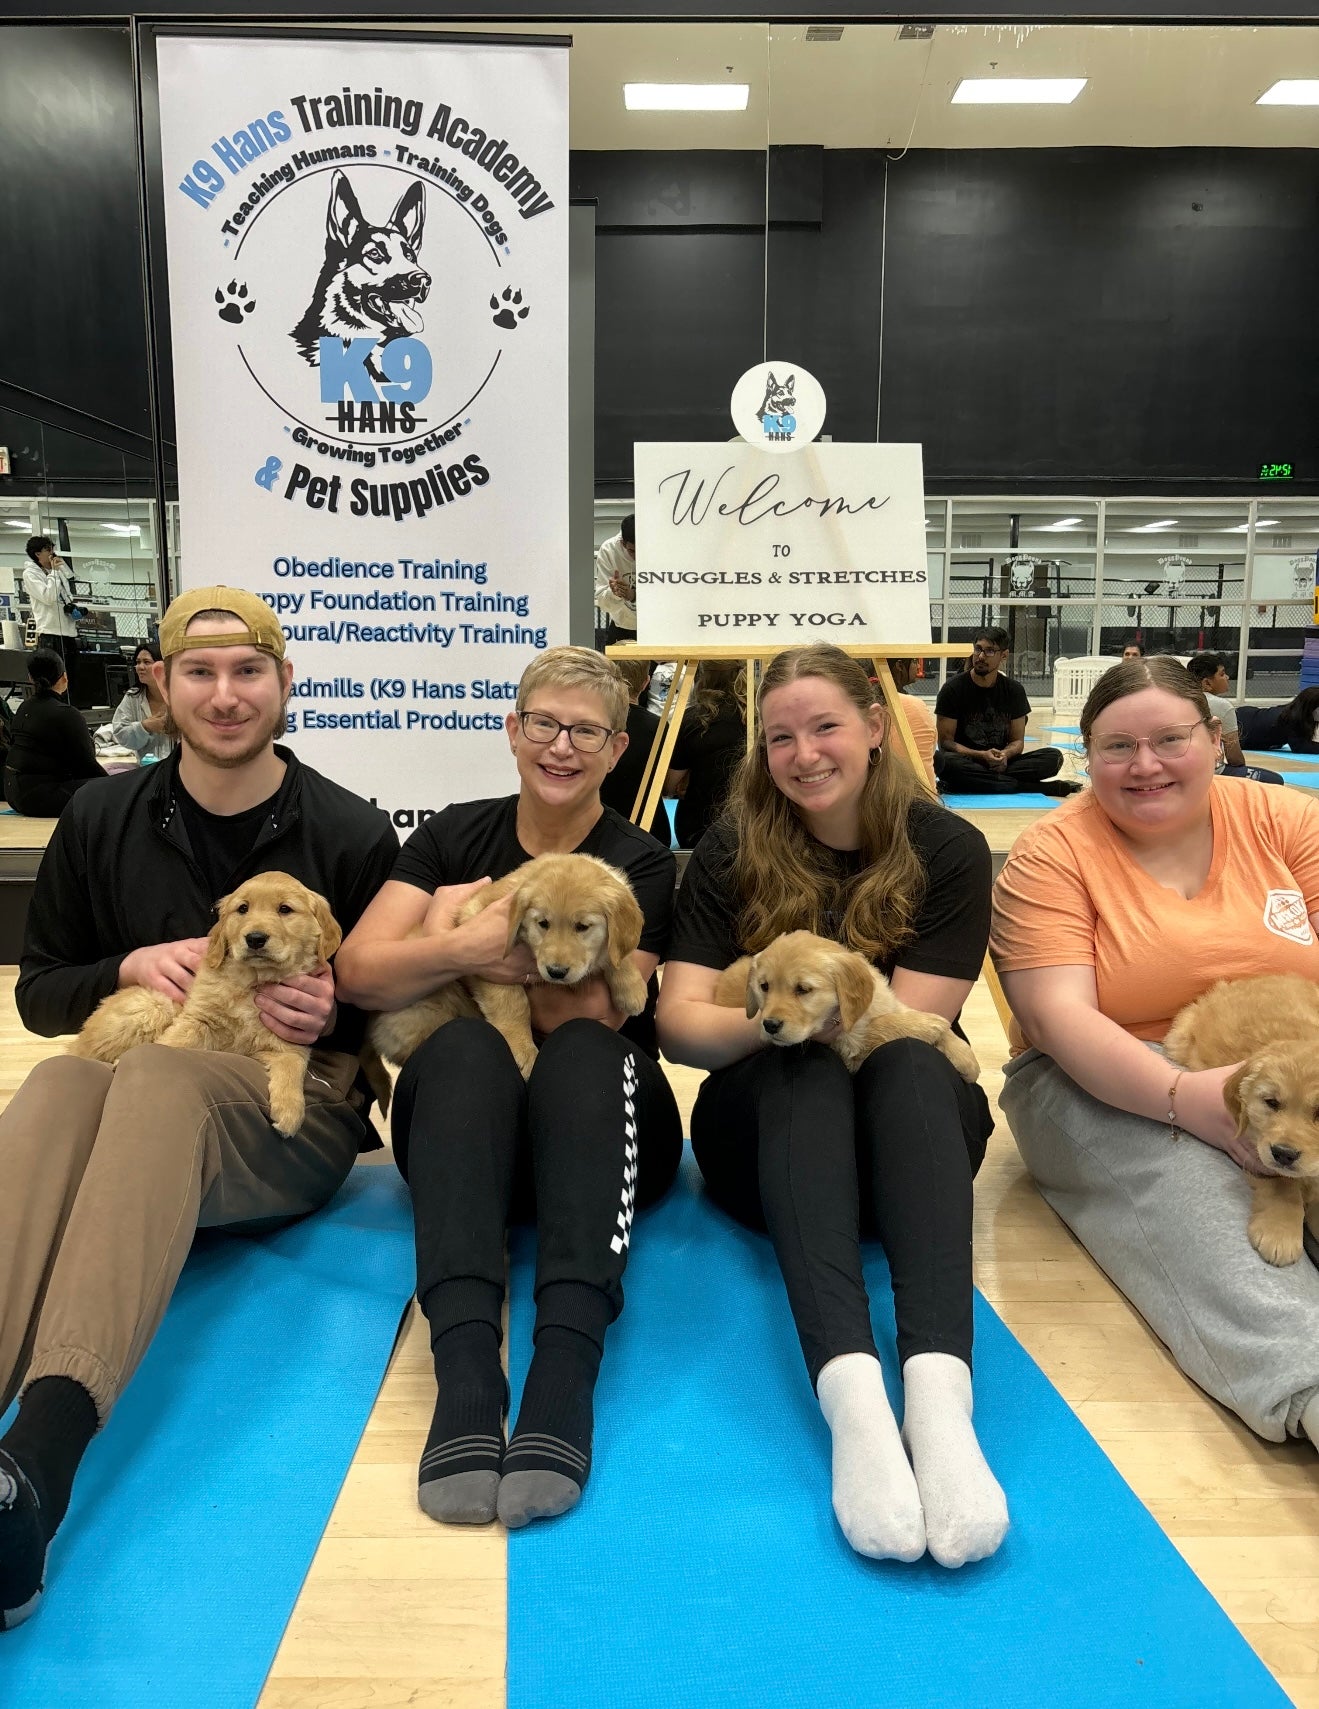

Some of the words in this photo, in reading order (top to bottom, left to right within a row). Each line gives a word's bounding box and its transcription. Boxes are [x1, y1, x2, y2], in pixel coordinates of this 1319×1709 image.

[178, 159, 226, 210] K9
[211, 110, 292, 175] Hans
[290, 87, 423, 137] Training
[426, 103, 555, 220] Academy
[220, 163, 297, 236] Teaching
[291, 143, 377, 171] Humans
[395, 143, 475, 203] Training
[470, 192, 509, 246] Dogs
[319, 336, 433, 404] K9
[337, 400, 415, 434] HANS
[763, 414, 797, 433] K9
[291, 427, 376, 468] Growing
[377, 421, 464, 464] Together
[768, 432, 792, 442] HANS
[254, 455, 283, 492] &
[283, 462, 342, 514] Pet
[349, 453, 491, 522] Supplies
[658, 465, 891, 526] Welcome
[772, 544, 791, 558] TO
[273, 556, 395, 579] Obedience
[397, 558, 489, 585] Training
[637, 571, 763, 585] SNUGGLES
[768, 571, 783, 584] &
[788, 570, 927, 584] STRETCHES
[256, 591, 305, 615] ppy
[310, 589, 437, 612] Foundation
[439, 590, 530, 617] Training
[281, 620, 456, 648] oural/Reactivity
[459, 623, 549, 649] Training
[697, 613, 781, 628] PUPPY
[789, 612, 868, 627] YOGA
[290, 677, 365, 699] admills
[370, 678, 407, 701] (K9
[411, 679, 467, 700] Hans
[302, 709, 402, 731] Essential
[406, 711, 505, 731] Products
